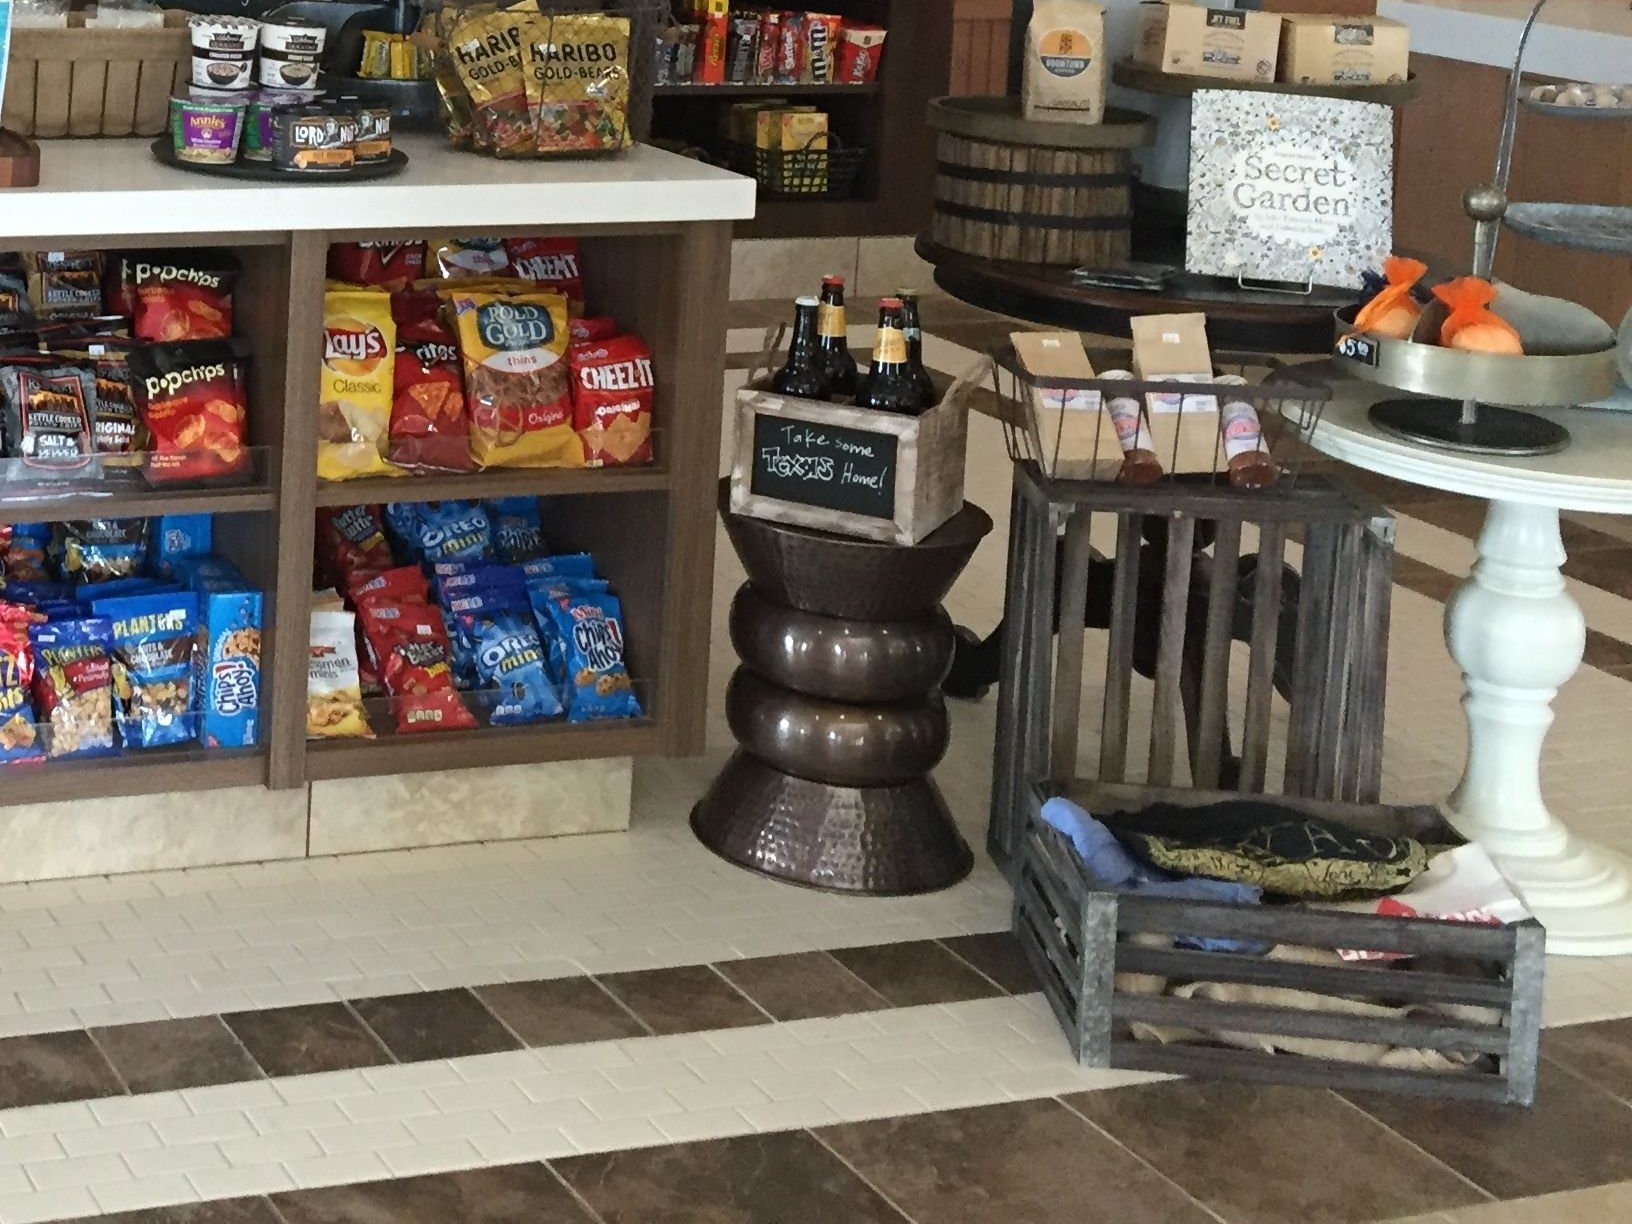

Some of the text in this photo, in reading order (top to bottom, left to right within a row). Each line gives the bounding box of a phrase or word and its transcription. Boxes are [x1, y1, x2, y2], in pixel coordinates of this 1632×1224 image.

[456, 25, 521, 66] HARIB
[529, 41, 617, 64] HARIBO
[294, 125, 325, 149] LORD
[1243, 154, 1348, 188] Secret
[1232, 182, 1352, 217] Garden
[488, 302, 539, 323] ROLD
[324, 328, 381, 361] Lay's
[485, 320, 547, 346] GOLD
[416, 340, 458, 363] ritos
[332, 379, 383, 395] Classic
[579, 358, 655, 391] CHEEZ-IT
[39, 434, 66, 448] SALT
[95, 420, 136, 436] RIGINAL
[779, 424, 875, 459] Take some
[840, 465, 889, 497] Home!
[421, 516, 487, 548] OREO
